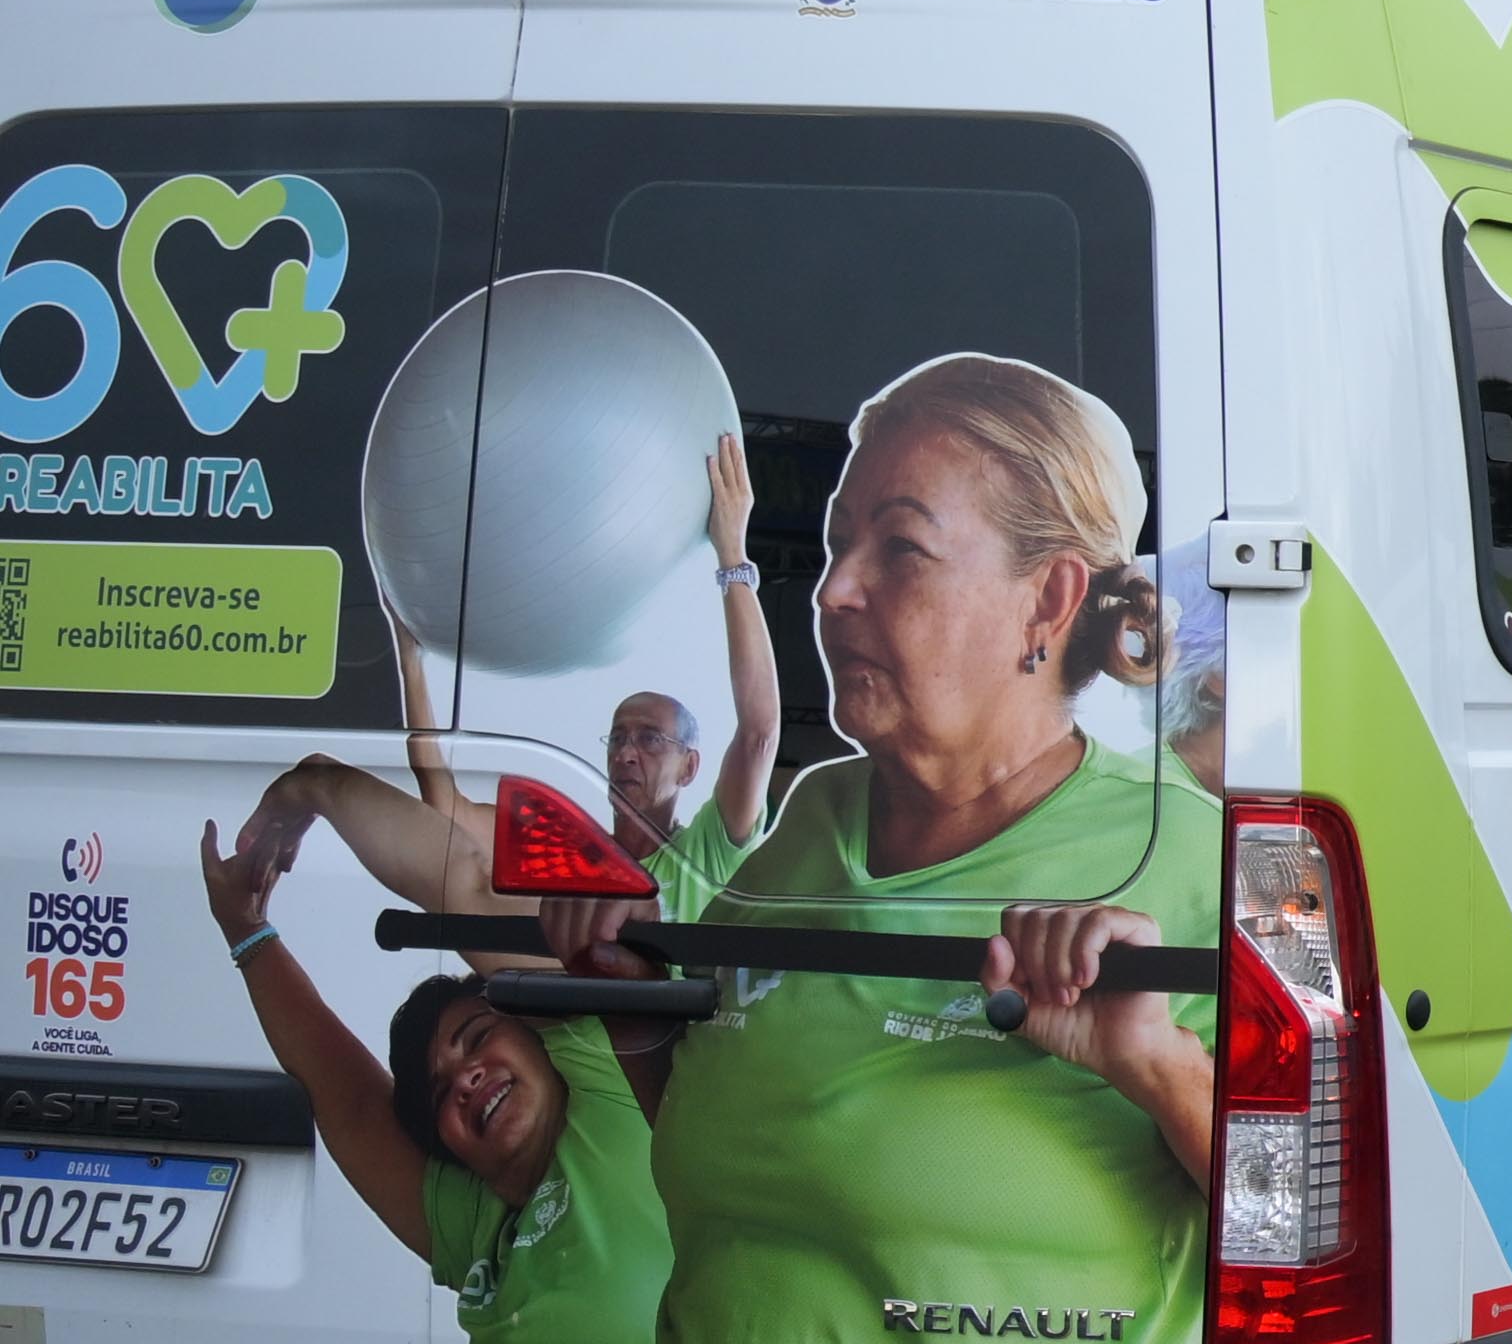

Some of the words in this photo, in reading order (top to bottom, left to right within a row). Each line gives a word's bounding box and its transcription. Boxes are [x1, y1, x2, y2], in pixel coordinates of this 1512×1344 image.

[0, 454, 273, 519] REABILITA
[98, 577, 261, 611] Inscreva-se
[57, 622, 308, 654] reabilita60.com.br
[29, 892, 129, 924] DISQUE
[27, 922, 128, 958] IDOSO
[26, 957, 125, 1021] 165
[32, 1041, 40, 1051] A
[41, 1042, 75, 1053] GENTE
[77, 1043, 113, 1056] CUIDA.
[44, 1026, 73, 1040] VOCÊ
[75, 1030, 102, 1043] LIGA,
[66, 1161, 112, 1178] BRASIL
[883, 1299, 1136, 1341] RENAULT
